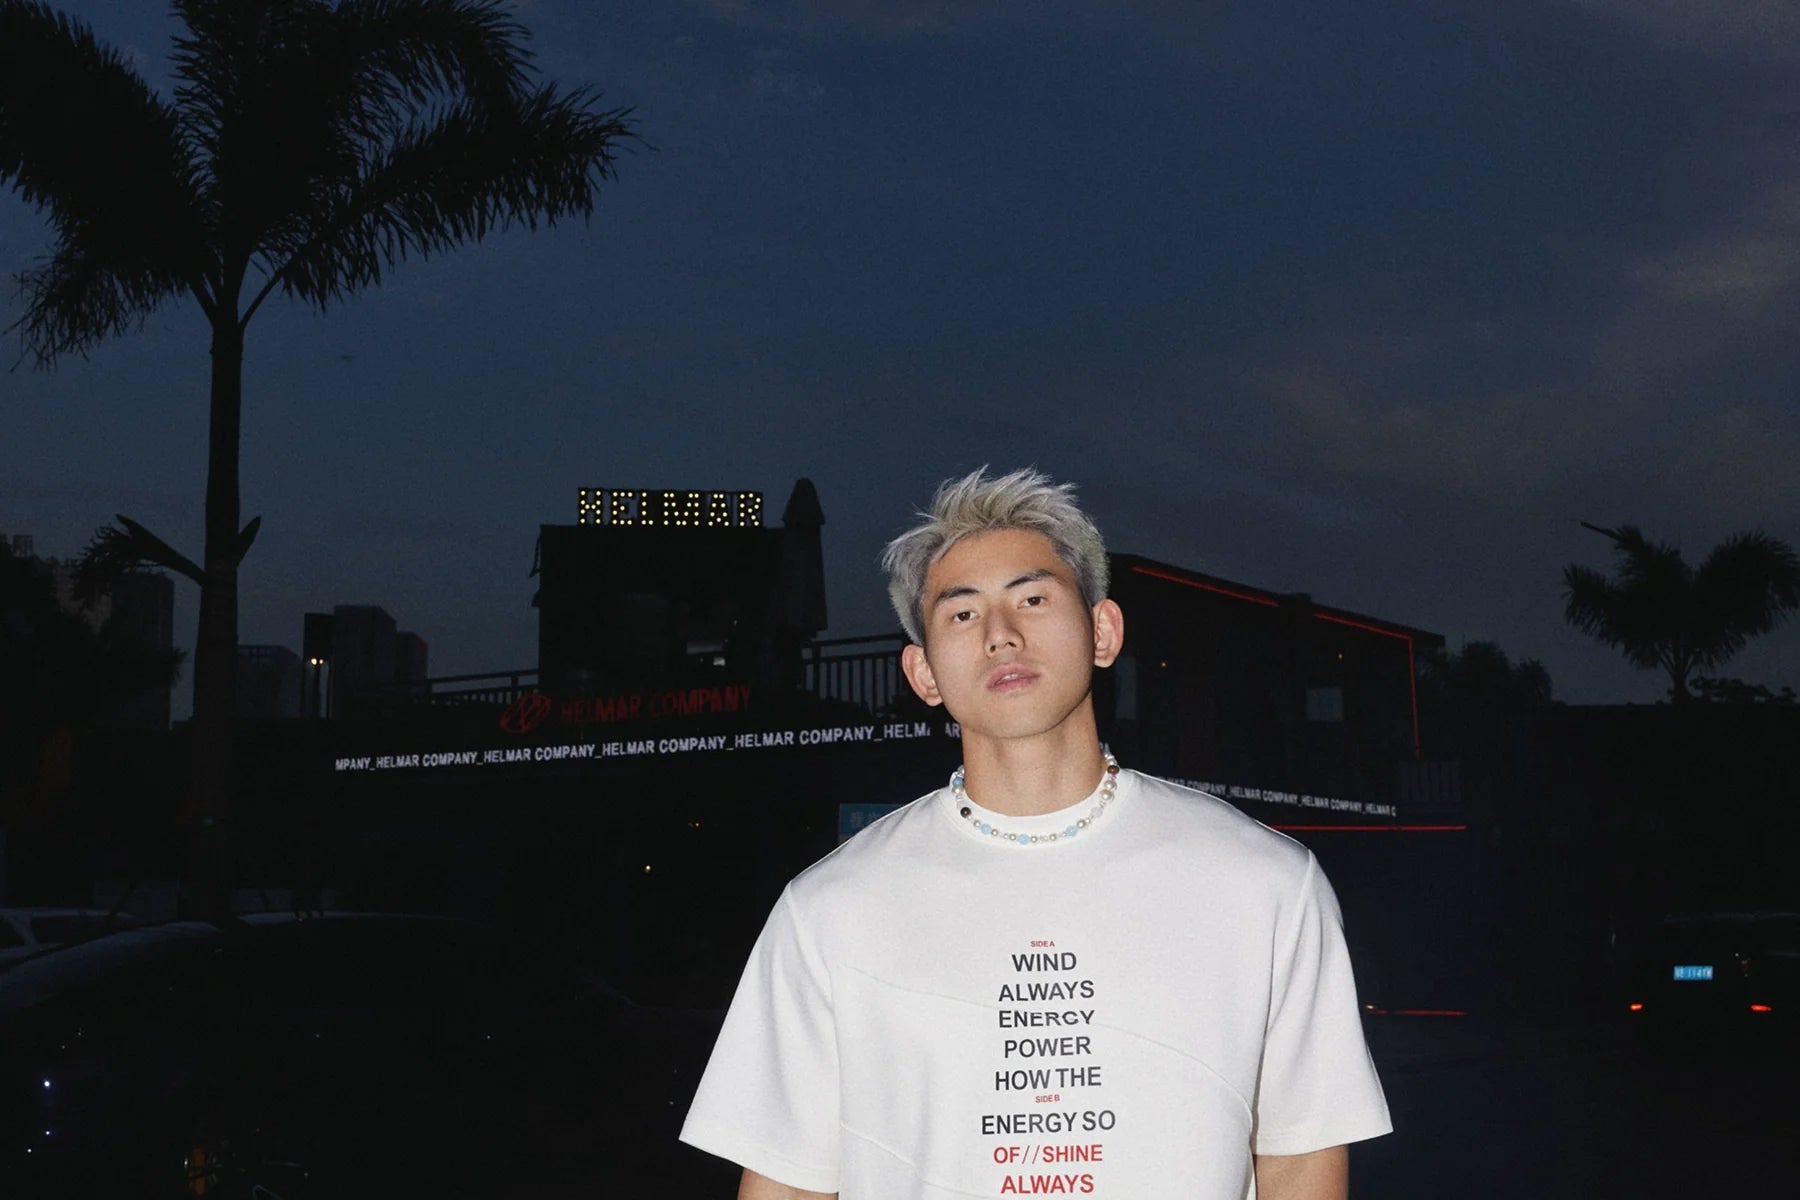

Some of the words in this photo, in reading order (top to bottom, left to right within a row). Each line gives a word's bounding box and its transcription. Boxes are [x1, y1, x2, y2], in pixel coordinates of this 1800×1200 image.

[578, 488, 764, 527] HELMAR
[560, 695, 641, 724] HELMAR
[649, 683, 752, 719] COMPANY
[1030, 940, 1049, 948] SIDE
[1049, 940, 1056, 948] A
[1011, 952, 1078, 972] WIND
[998, 979, 1095, 1002] ALWAYS
[1004, 1036, 1092, 1059] POWER
[995, 1069, 1051, 1091] HOW
[1055, 1066, 1102, 1088] THE
[1035, 1095, 1054, 1104] SIDE
[1054, 1094, 1060, 1102] B
[981, 1112, 1078, 1135] ENERGY
[1082, 1110, 1117, 1132] SO
[1000, 1173, 1095, 1194] ALWAYS
